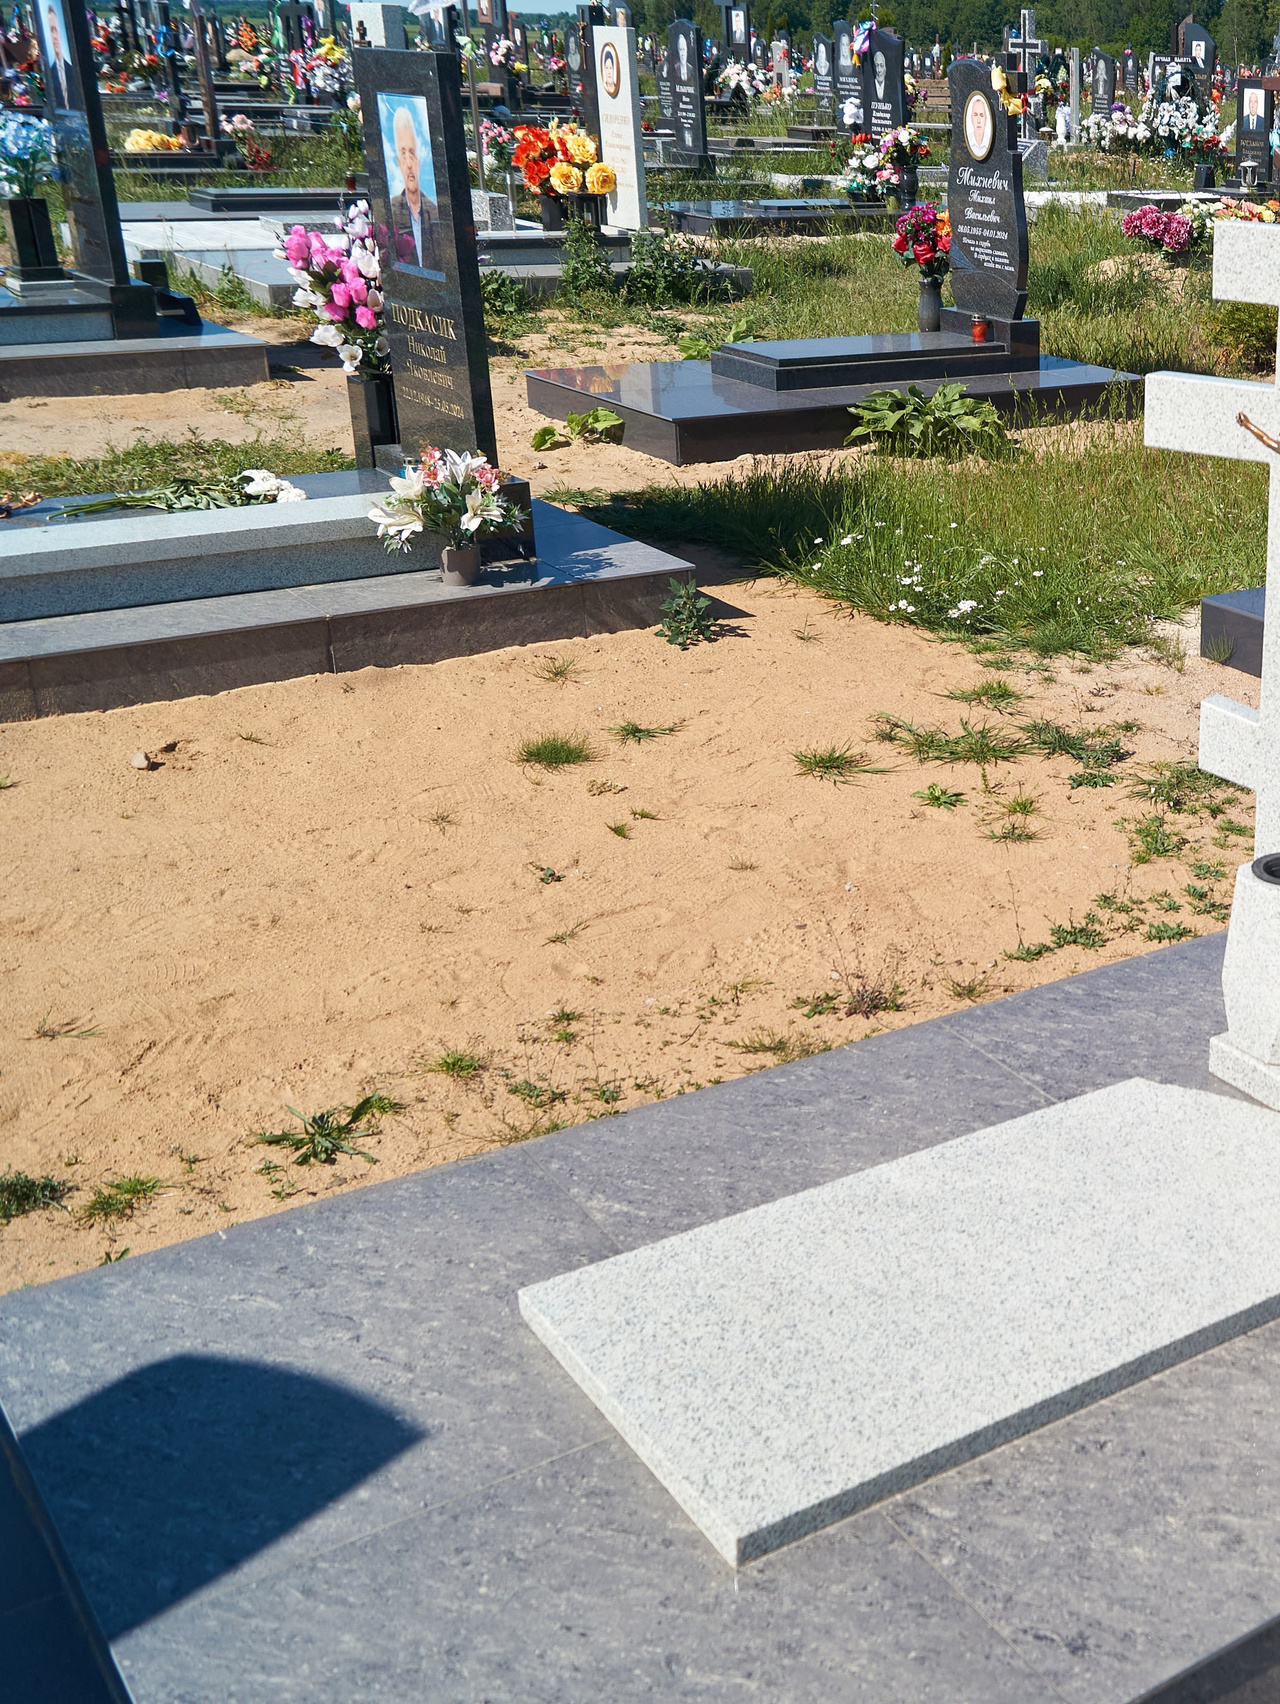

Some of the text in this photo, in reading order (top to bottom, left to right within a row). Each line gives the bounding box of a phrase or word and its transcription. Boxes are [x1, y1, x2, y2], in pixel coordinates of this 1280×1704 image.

[956, 166, 1010, 191] Михневич
[391, 302, 458, 341] ПОДКАСИК
[407, 334, 447, 364] Николай
[406, 358, 455, 390] Яковлевич
